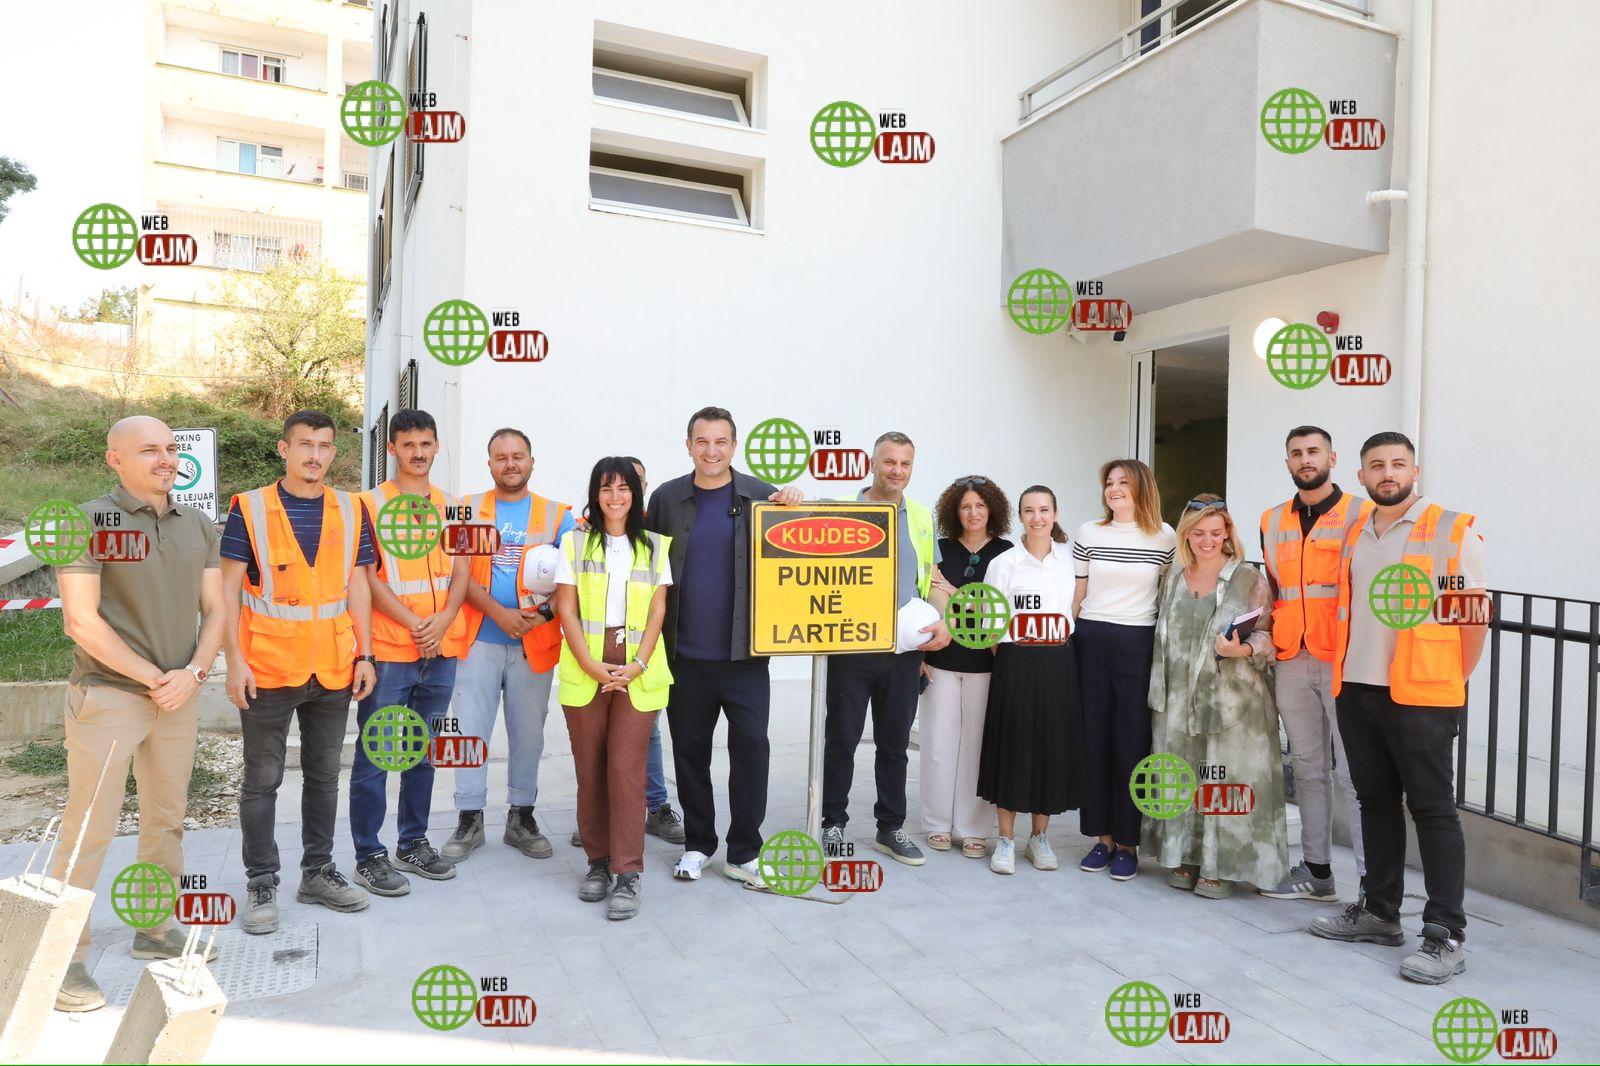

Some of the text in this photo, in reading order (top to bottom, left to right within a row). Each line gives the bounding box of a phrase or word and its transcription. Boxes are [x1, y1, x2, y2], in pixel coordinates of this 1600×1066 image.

[174, 434, 201, 442] OKING
[176, 443, 192, 451] REA
[184, 493, 214, 501] LEJUAR
[781, 527, 871, 545] KUJDES
[778, 565, 874, 586] PUNIME
[809, 590, 843, 615] NË
[772, 618, 877, 644] LARTËSI
